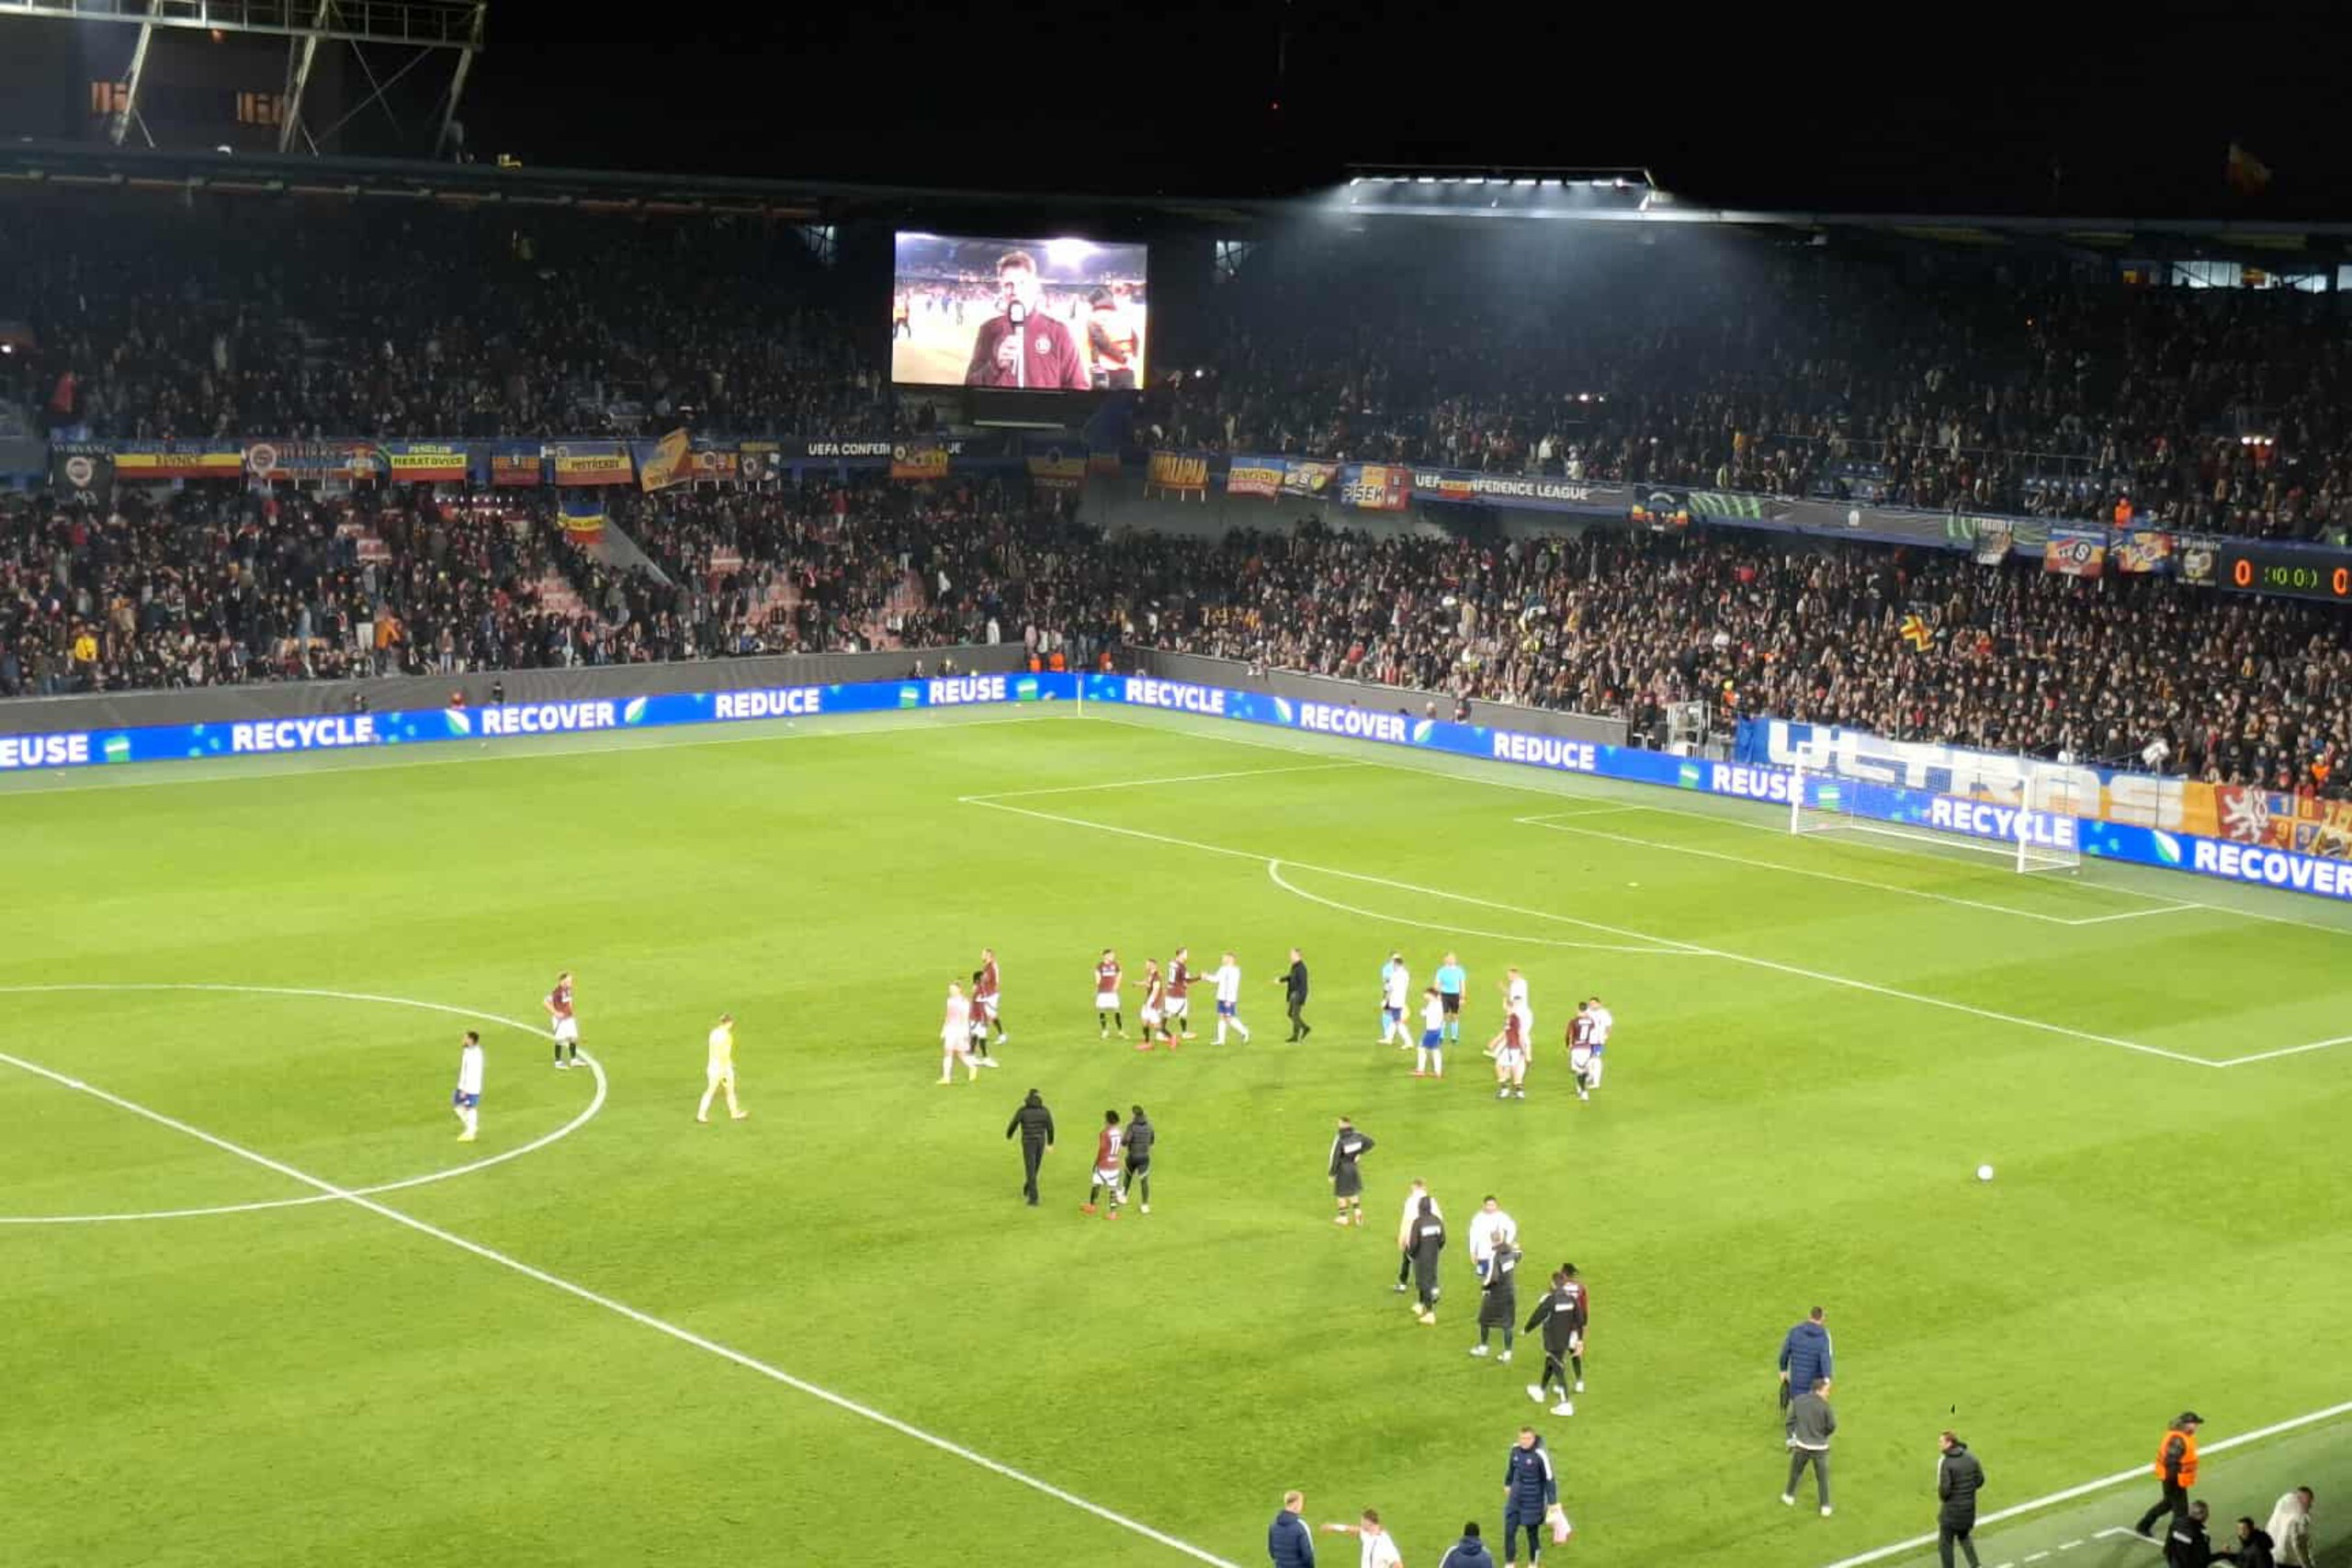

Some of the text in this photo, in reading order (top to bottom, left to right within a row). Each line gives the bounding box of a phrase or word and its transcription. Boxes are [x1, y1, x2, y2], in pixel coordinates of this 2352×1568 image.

[808, 443, 840, 456] UEFA
[1415, 473, 1589, 501] UEF NFERENCE LEAGUE
[2235, 559, 2251, 585] 0
[715, 688, 820, 720] REDUCE
[928, 677, 1007, 705] REUSE
[1125, 678, 1225, 715] RECYCLE
[232, 716, 375, 753] RECYCLE
[481, 701, 616, 734] RECOVER
[1299, 703, 1407, 742] RECOVER
[0, 734, 88, 767] EUSE
[1493, 732, 1595, 772] REDUCE
[1712, 763, 1804, 804] REUSE
[1769, 718, 2185, 826] ULTRAS
[1931, 797, 2075, 847] RECYCLE
[2194, 840, 2352, 896] RECOVER
